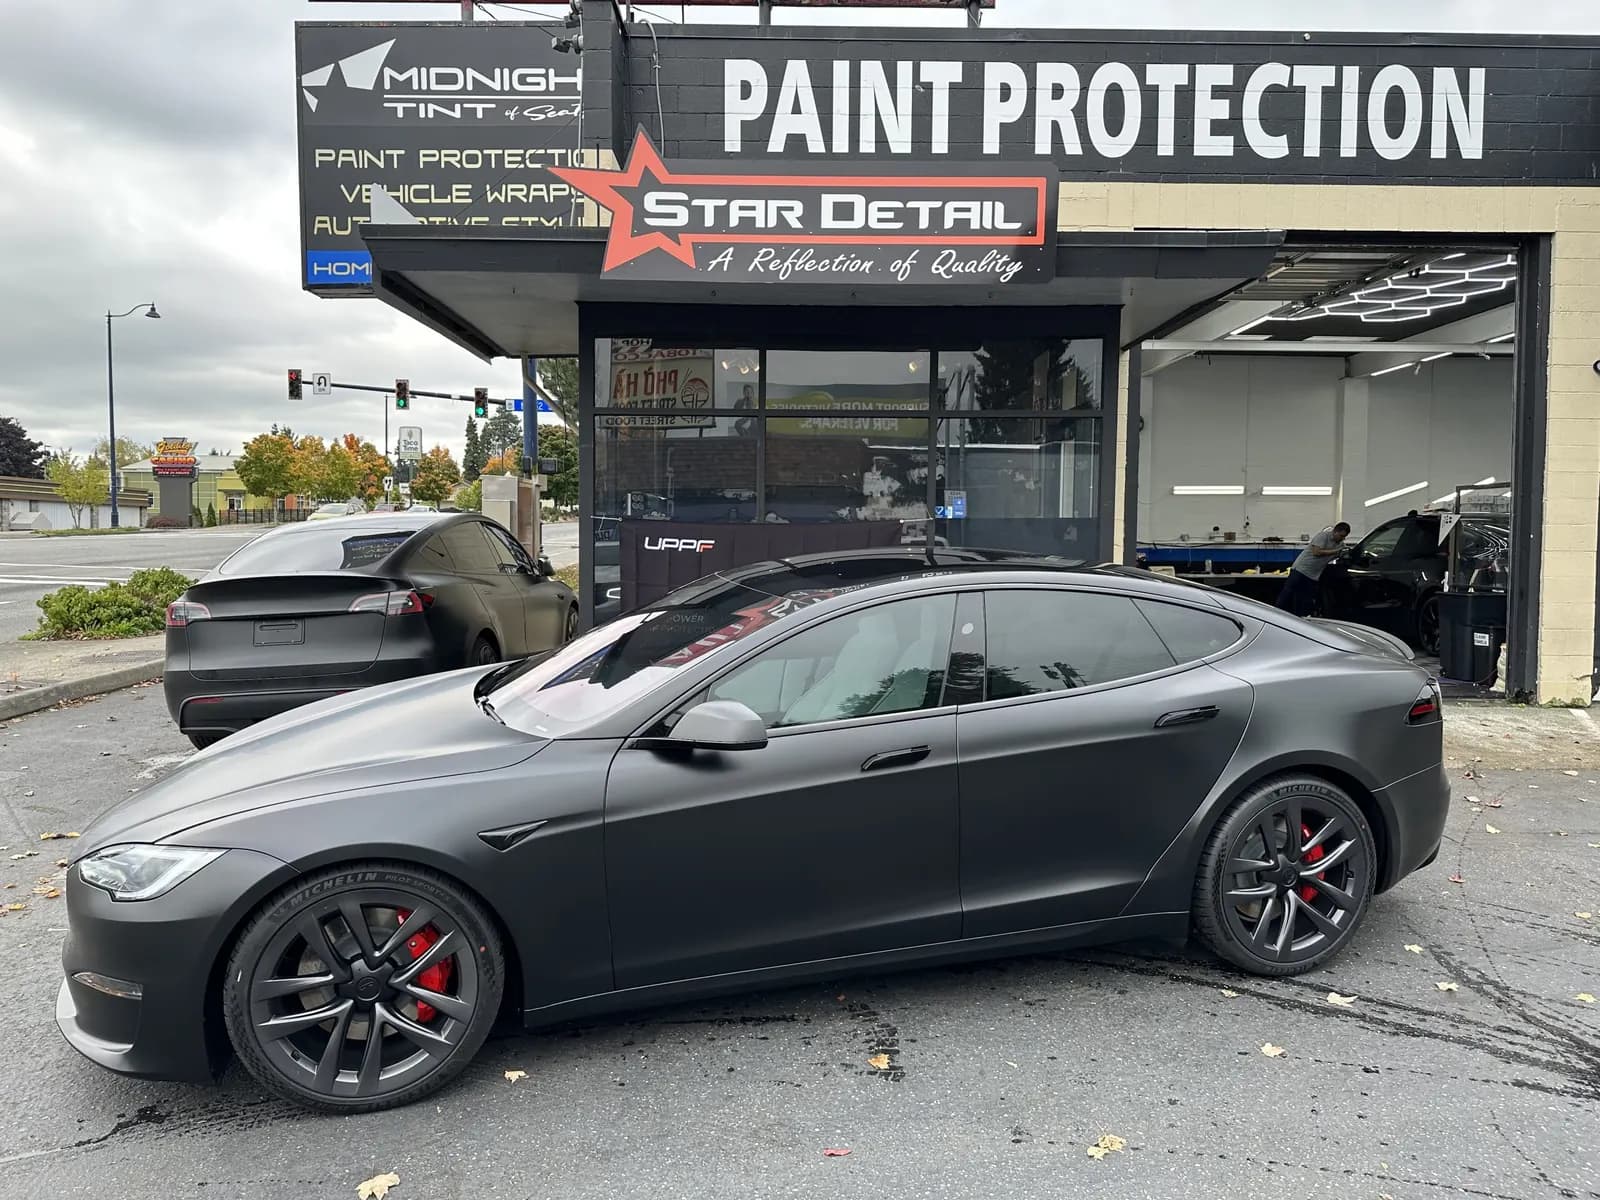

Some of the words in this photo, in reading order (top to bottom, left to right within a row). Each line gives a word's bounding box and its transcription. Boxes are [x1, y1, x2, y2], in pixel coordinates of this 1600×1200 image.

[383, 103, 496, 119] TINT
[504, 105, 520, 120] of
[723, 57, 963, 155] PAINT
[982, 61, 1486, 161] PROTECTION
[315, 149, 406, 169] PAINT
[340, 183, 473, 204] VEHICLE
[313, 262, 373, 276] HOM
[707, 247, 735, 273] A
[748, 248, 872, 282] Reflection
[889, 249, 920, 281] of
[931, 248, 1024, 283] Quality
[644, 537, 715, 552] UPPF
[291, 872, 378, 907] MICHELIN
